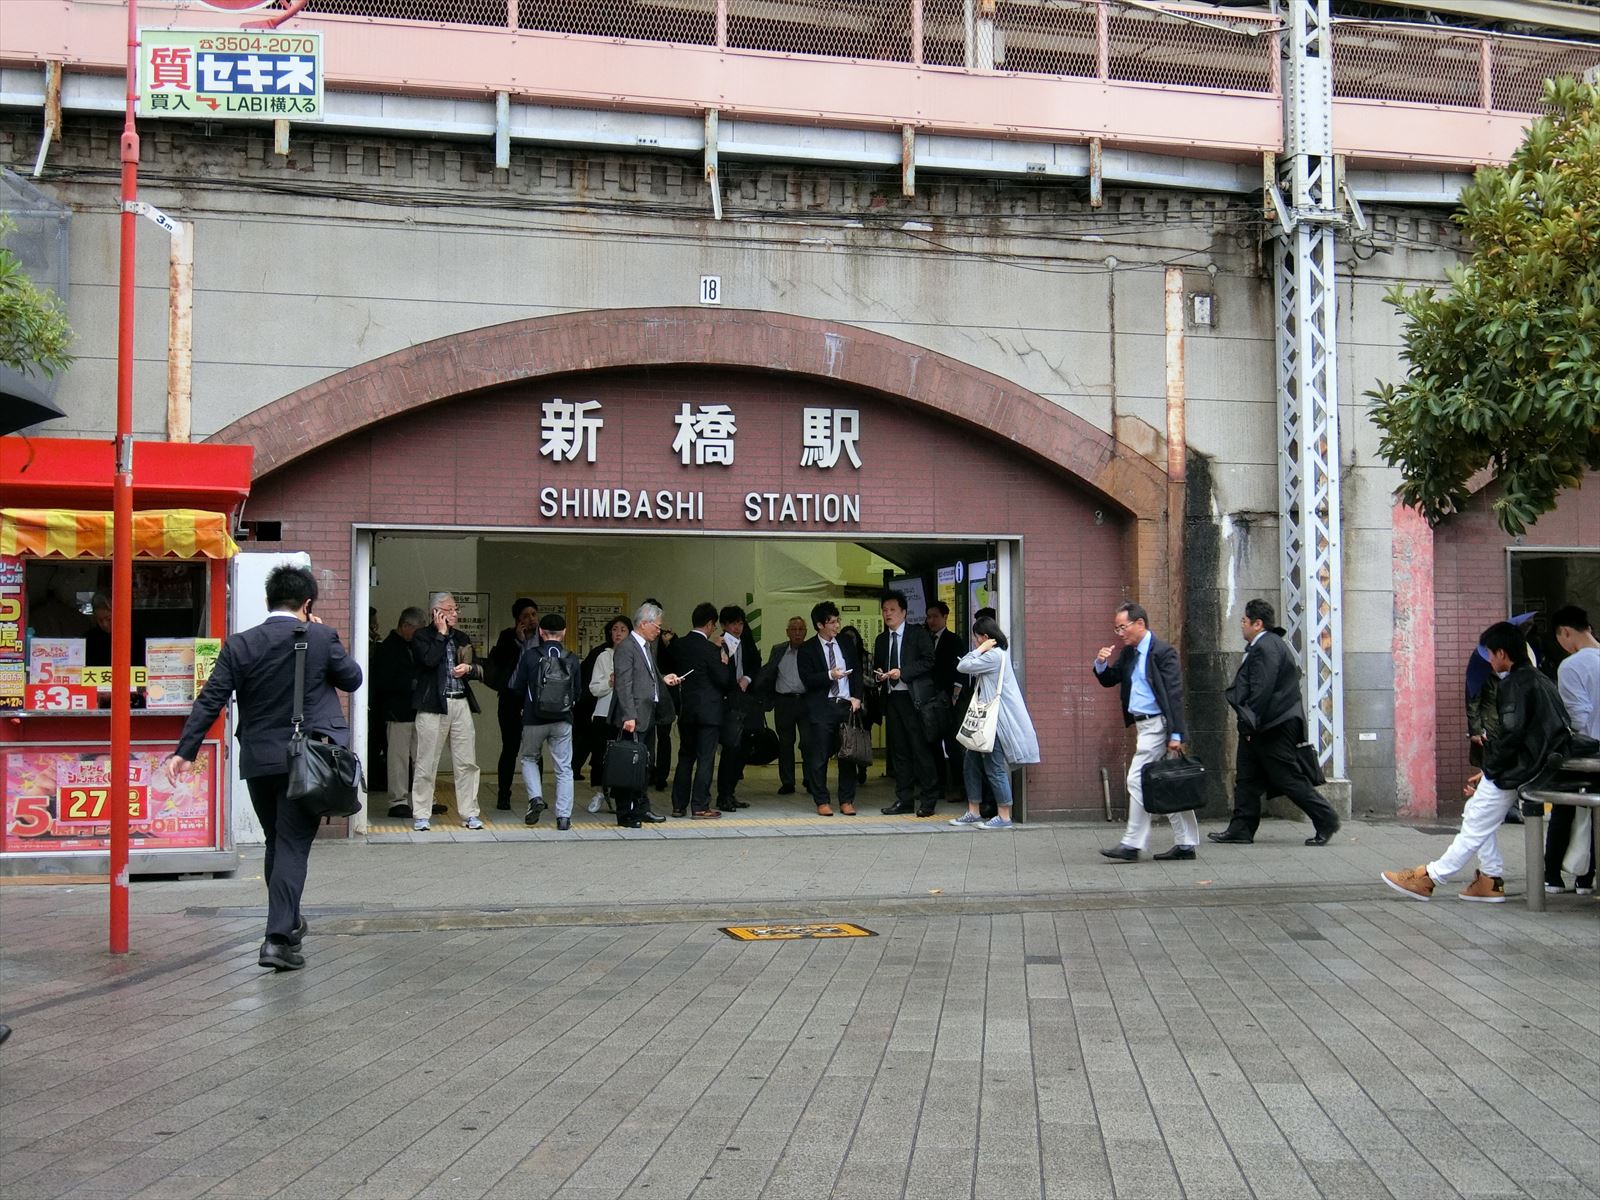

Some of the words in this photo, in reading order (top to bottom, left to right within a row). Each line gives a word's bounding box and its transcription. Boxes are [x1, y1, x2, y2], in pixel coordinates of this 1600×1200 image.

[215, 37, 314, 54] 3504-2070
[150, 48, 192, 91] 質
[198, 54, 314, 94] セキネ
[151, 94, 191, 111] 買入
[702, 279, 718, 300] 18
[540, 487, 704, 520] SHIMBASHI
[744, 492, 861, 523] STATION
[84, 670, 146, 684] 大安日
